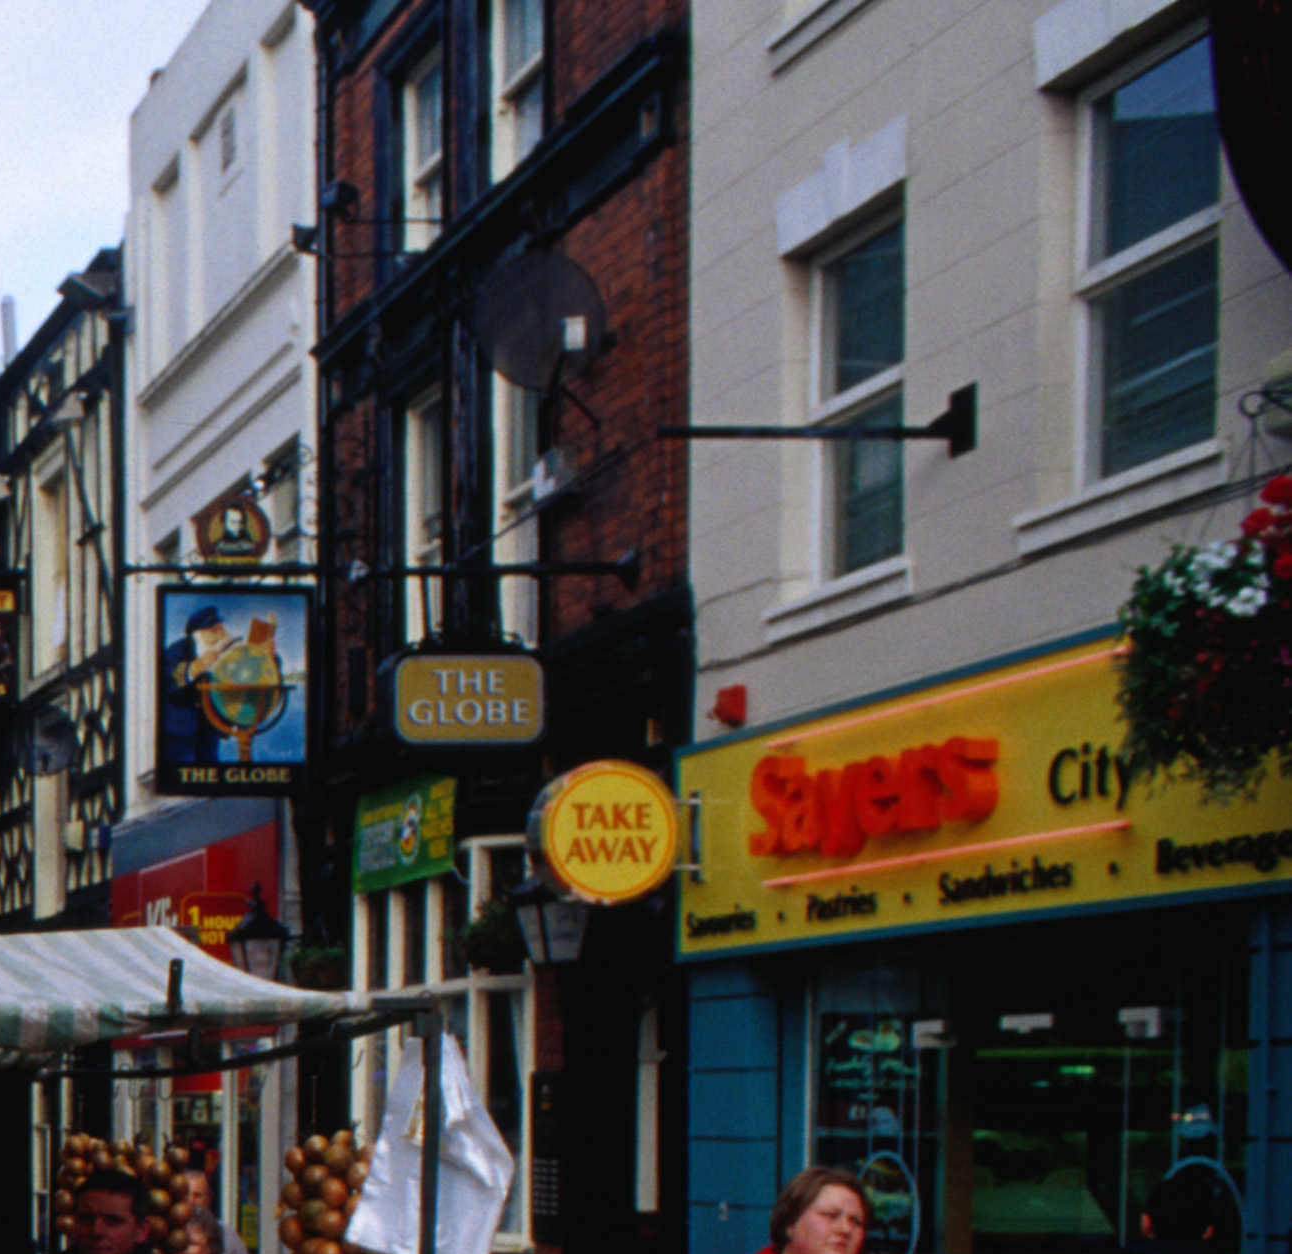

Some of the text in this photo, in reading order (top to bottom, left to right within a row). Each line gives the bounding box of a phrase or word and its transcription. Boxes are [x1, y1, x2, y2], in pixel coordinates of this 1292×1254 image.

[433, 670, 505, 696] THE
[409, 699, 530, 726] GLOBE
[179, 766, 290, 783] THE GLOBE
[748, 737, 1139, 858] Sayers City
[571, 802, 652, 831] TAKE
[565, 834, 658, 864] AWAY
[686, 904, 758, 938] Savouries
[806, 886, 878, 923] Pastries
[937, 857, 1073, 905] Sandwiches
